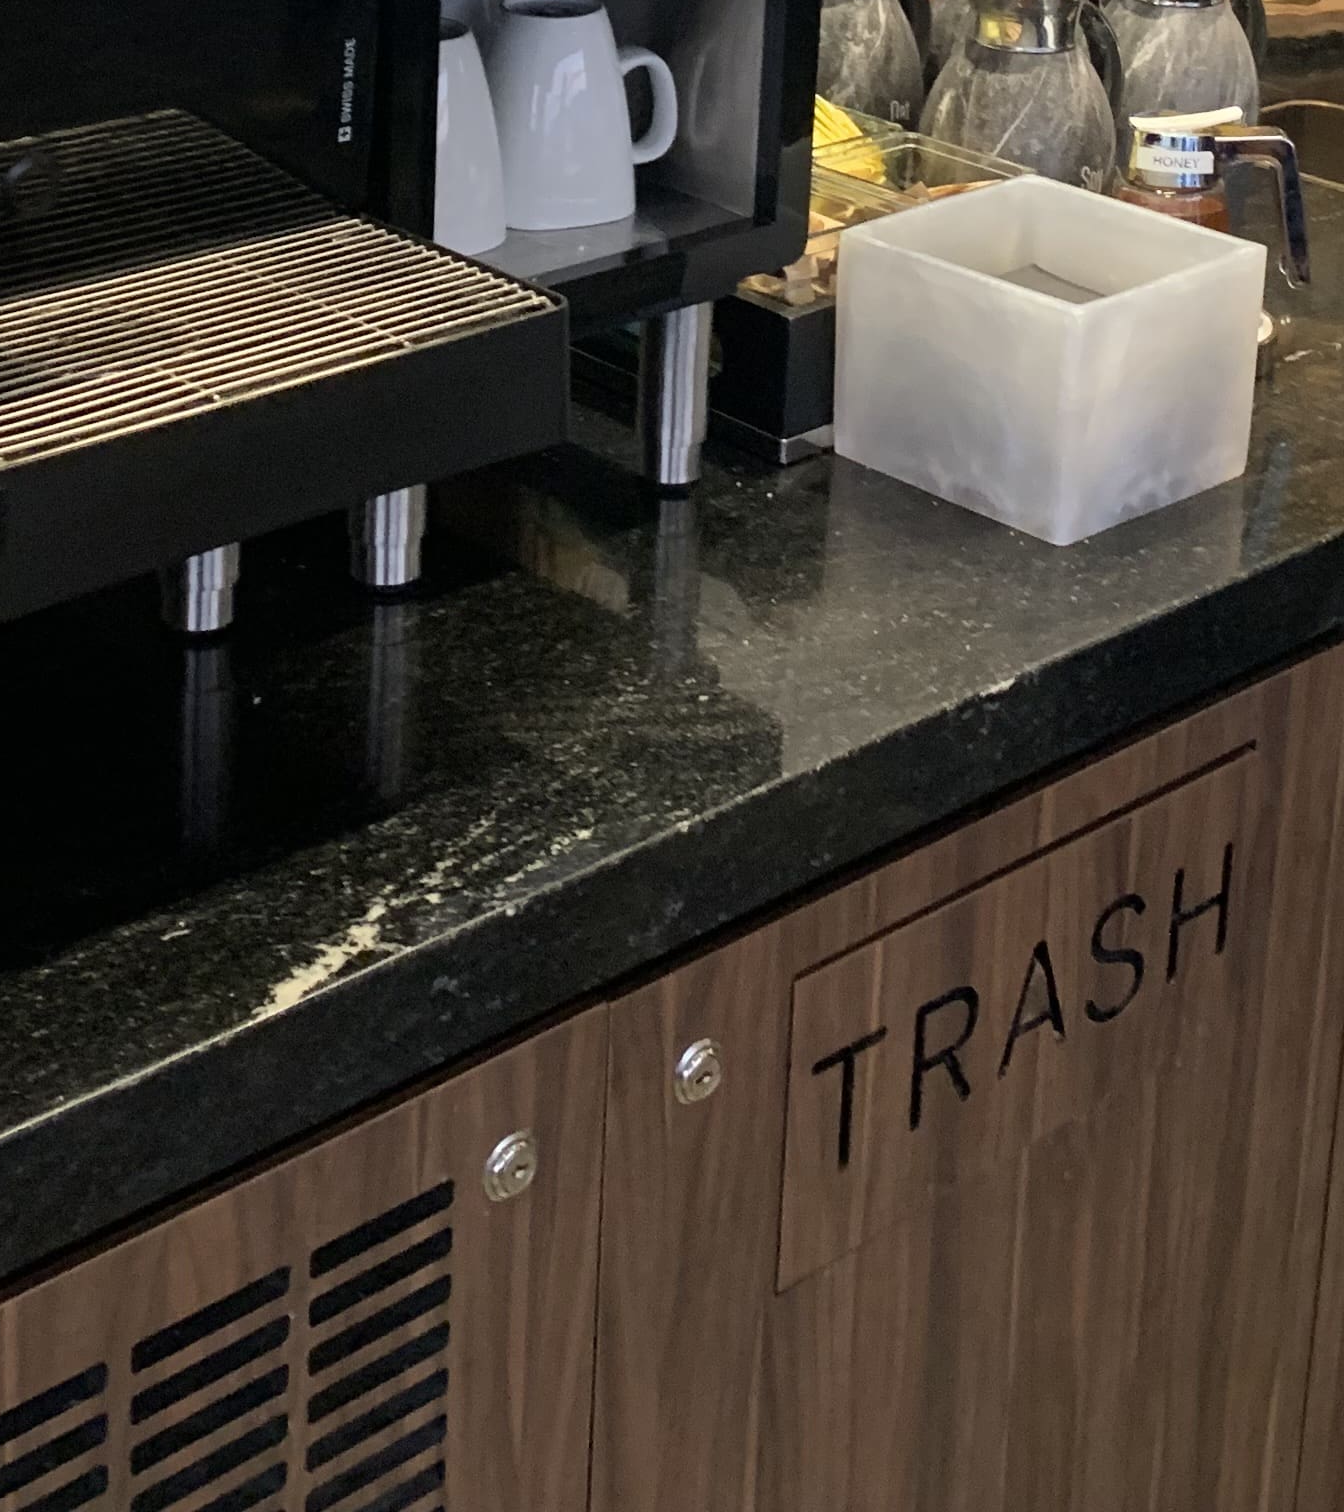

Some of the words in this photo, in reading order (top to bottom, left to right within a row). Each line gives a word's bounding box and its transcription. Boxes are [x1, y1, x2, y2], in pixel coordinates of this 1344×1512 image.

[343, 37, 356, 78] MADE
[340, 80, 354, 123] SWISS
[1152, 156, 1201, 169] HONEY
[811, 841, 1235, 1169] TRASH
